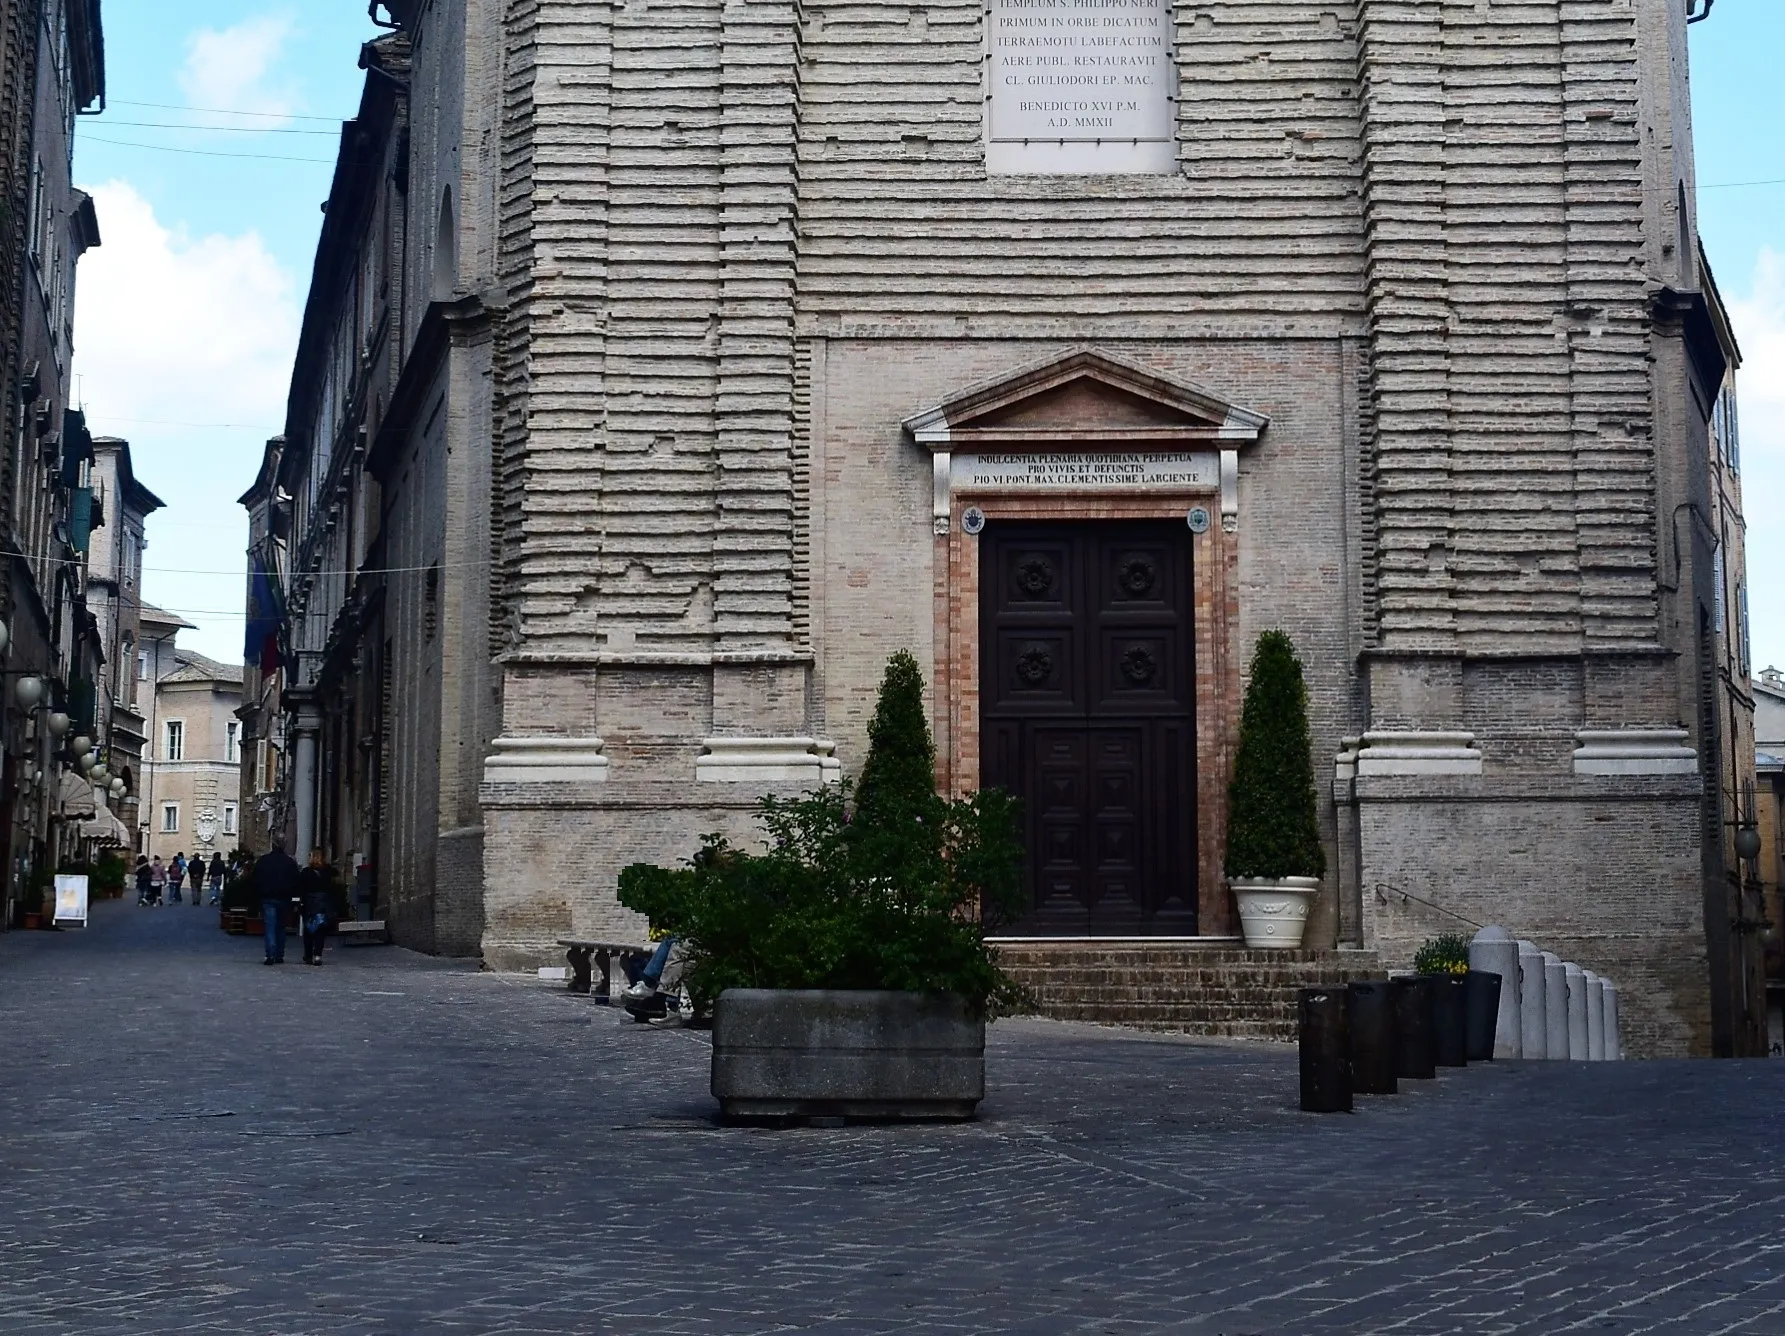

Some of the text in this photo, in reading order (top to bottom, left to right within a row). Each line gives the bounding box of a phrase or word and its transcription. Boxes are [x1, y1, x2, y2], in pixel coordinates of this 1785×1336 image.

[999, 17, 1158, 27] PRIMUM IN ORBE DICATUM
[997, 36, 1161, 46] TERRAEMOTU LABEFACTUM
[1001, 56, 1157, 66] AERE PUBL. RESTAURAVIT
[1005, 75, 1154, 85] CL. GIULIODORI EP. MAC.
[1020, 101, 1141, 111] BENEDICTO XVI P.M.
[1075, 117, 1113, 127] MMXII
[1039, 454, 1083, 464] PLENARIA
[1085, 454, 1141, 464] QUOTIDIANA
[1143, 453, 1192, 463] PERPETUA
[1028, 464, 1145, 474] PRO VIVIS ET DEFUNCTIS
[973, 475, 990, 484] PIO
